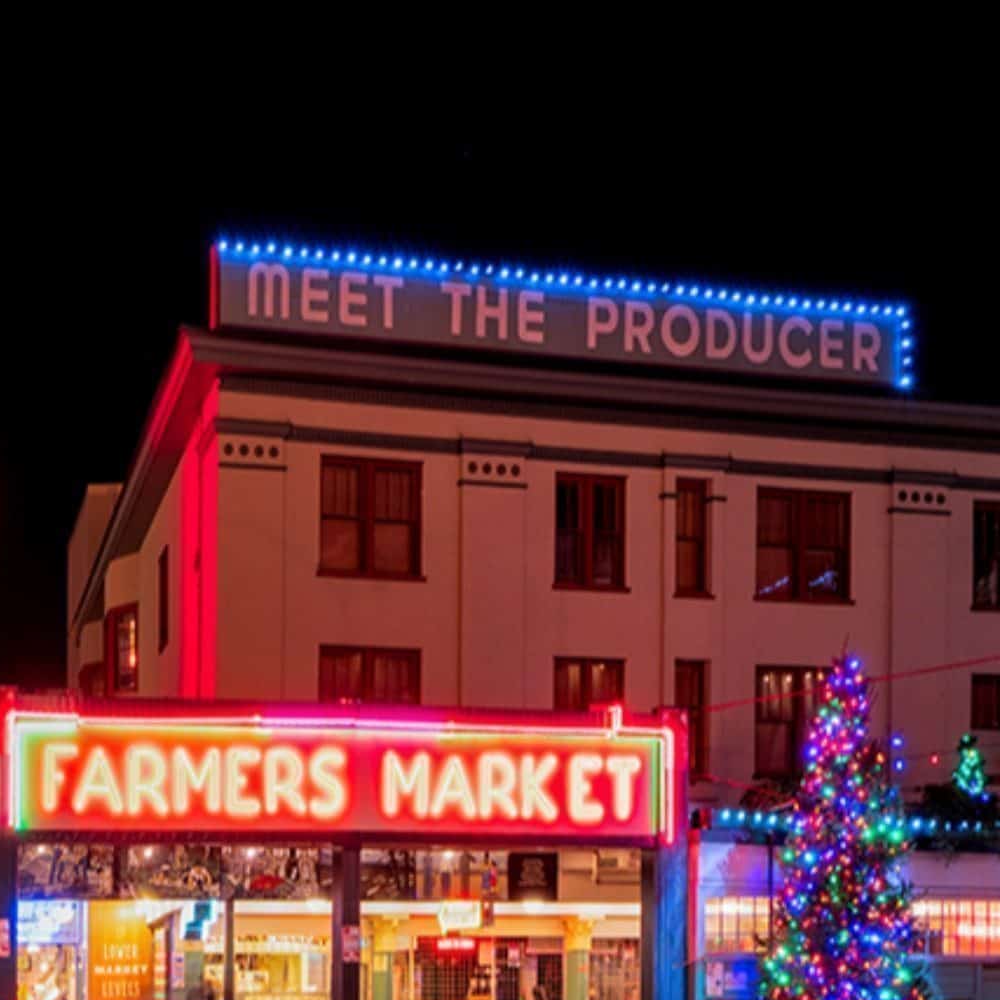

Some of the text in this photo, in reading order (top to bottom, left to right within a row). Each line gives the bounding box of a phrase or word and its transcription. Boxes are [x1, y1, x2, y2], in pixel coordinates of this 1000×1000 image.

[246, 262, 883, 373] MEET THE PRODUCER
[39, 743, 641, 822] FARMERS MARKET
